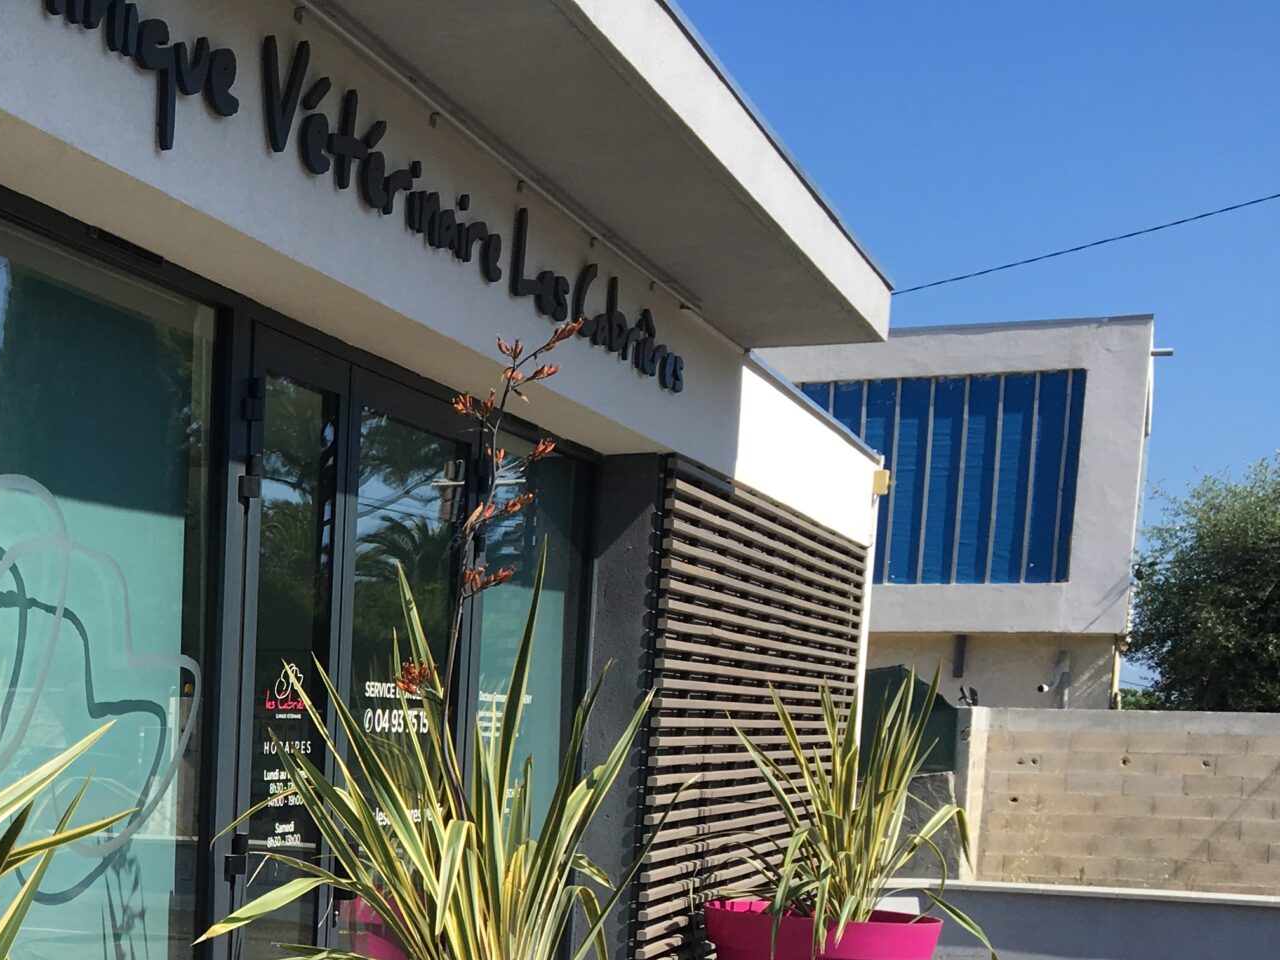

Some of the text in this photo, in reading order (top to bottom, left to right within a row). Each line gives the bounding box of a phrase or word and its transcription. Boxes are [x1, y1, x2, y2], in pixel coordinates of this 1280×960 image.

[263, 34, 503, 283] Vétérinaire
[510, 207, 570, 322] Les
[364, 681, 396, 698] SERVICE
[374, 708, 390, 733] 04
[391, 709, 404, 733] 93
[263, 768, 280, 781] Lundi
[274, 820, 295, 834] Samedi
